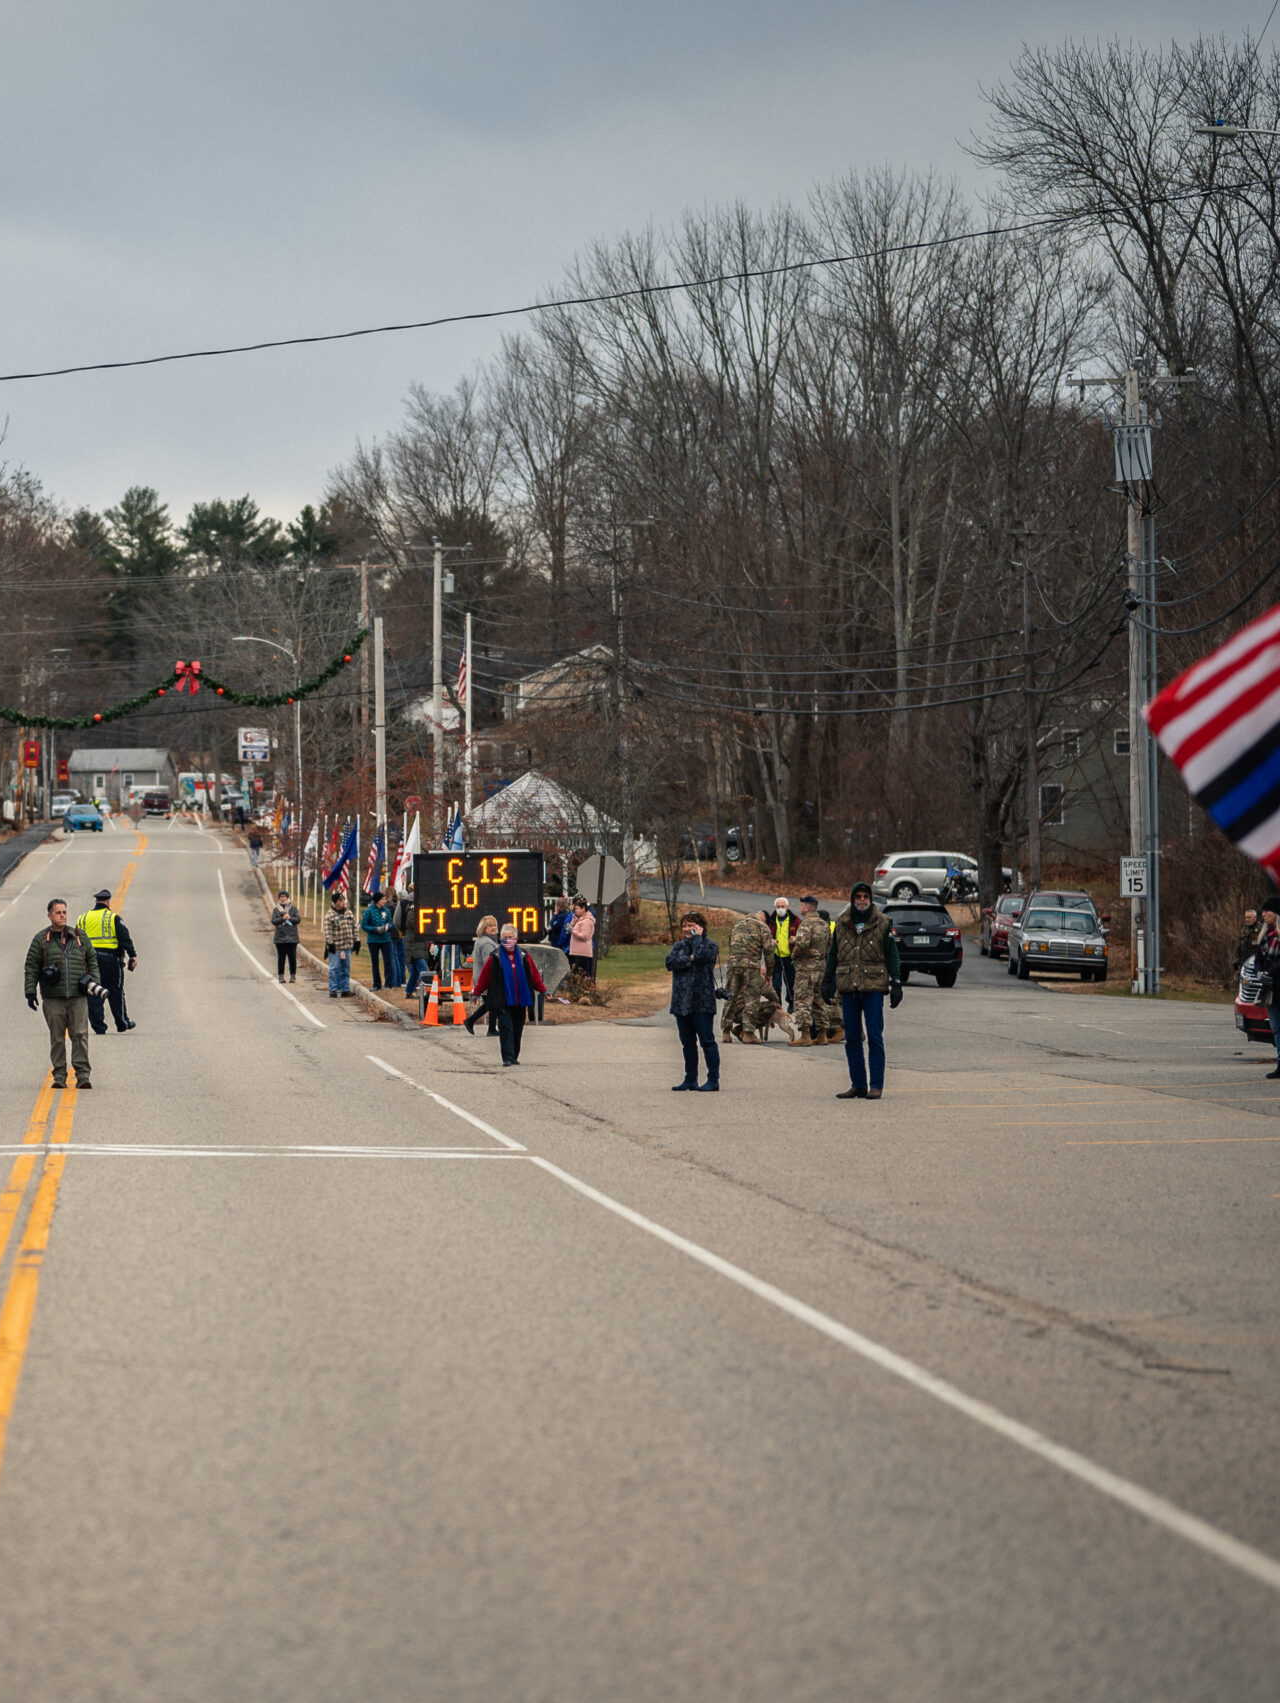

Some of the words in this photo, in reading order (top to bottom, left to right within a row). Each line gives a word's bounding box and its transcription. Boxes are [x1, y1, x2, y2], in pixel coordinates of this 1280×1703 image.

[447, 857, 463, 884] C
[479, 857, 509, 884] 13
[450, 883, 479, 909] 10
[1127, 877, 1143, 891] 15
[418, 908, 448, 935] FI
[507, 907, 538, 934] TA
